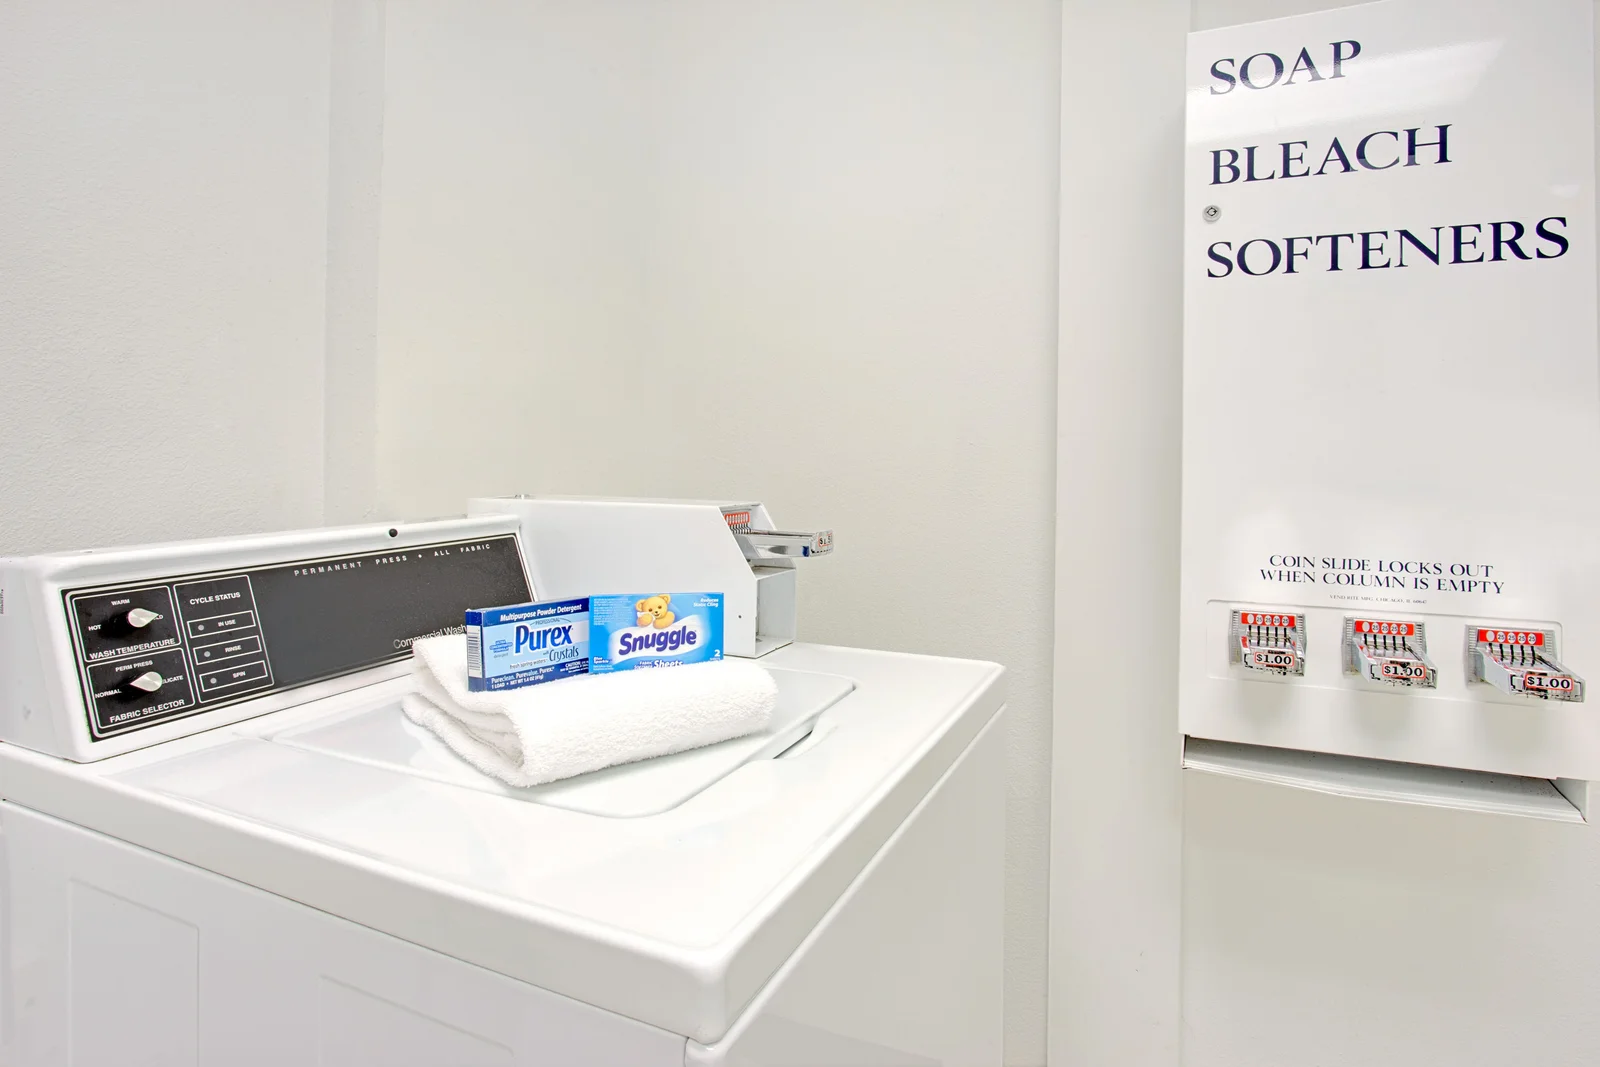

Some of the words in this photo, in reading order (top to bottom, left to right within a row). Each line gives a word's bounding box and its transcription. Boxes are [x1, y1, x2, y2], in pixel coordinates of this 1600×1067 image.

[1209, 39, 1362, 96] SOAP
[1208, 123, 1452, 186] BLEACH
[1206, 216, 1570, 278] SOFTENERS
[294, 561, 362, 577] PERMANENT
[376, 555, 408, 565] PRESS
[434, 549, 450, 557] ALL
[460, 543, 491, 553] FABRIC
[1269, 554, 1316, 568] COIN
[1322, 557, 1371, 571] SLIDE
[1378, 560, 1443, 575] LOCKS
[1450, 563, 1494, 577] OUT
[1260, 569, 1316, 583] WHEN
[1322, 572, 1406, 588] COLUMN
[1413, 577, 1429, 590] IS
[1437, 578, 1504, 594] EMPTY
[189, 596, 214, 605] CYCLE
[215, 592, 241, 602] STATUS
[500, 612, 536, 622] Multipurpose
[537, 606, 556, 617] Powder
[557, 604, 582, 613] Detergent
[89, 647, 116, 660] WASH
[116, 638, 176, 654] TEMPERATURE
[515, 624, 573, 654] Purex
[618, 625, 697, 656] Snuggle
[549, 646, 579, 662] Crystals
[1256, 654, 1292, 664] $1.00
[115, 664, 132, 672] PERM
[133, 660, 153, 669] PRESS
[1384, 666, 1423, 676] $1.00
[1527, 676, 1570, 689] $1.00
[94, 689, 122, 699] NORMAL
[109, 710, 141, 723] FABRIC
[142, 699, 185, 714] SELECTOR
